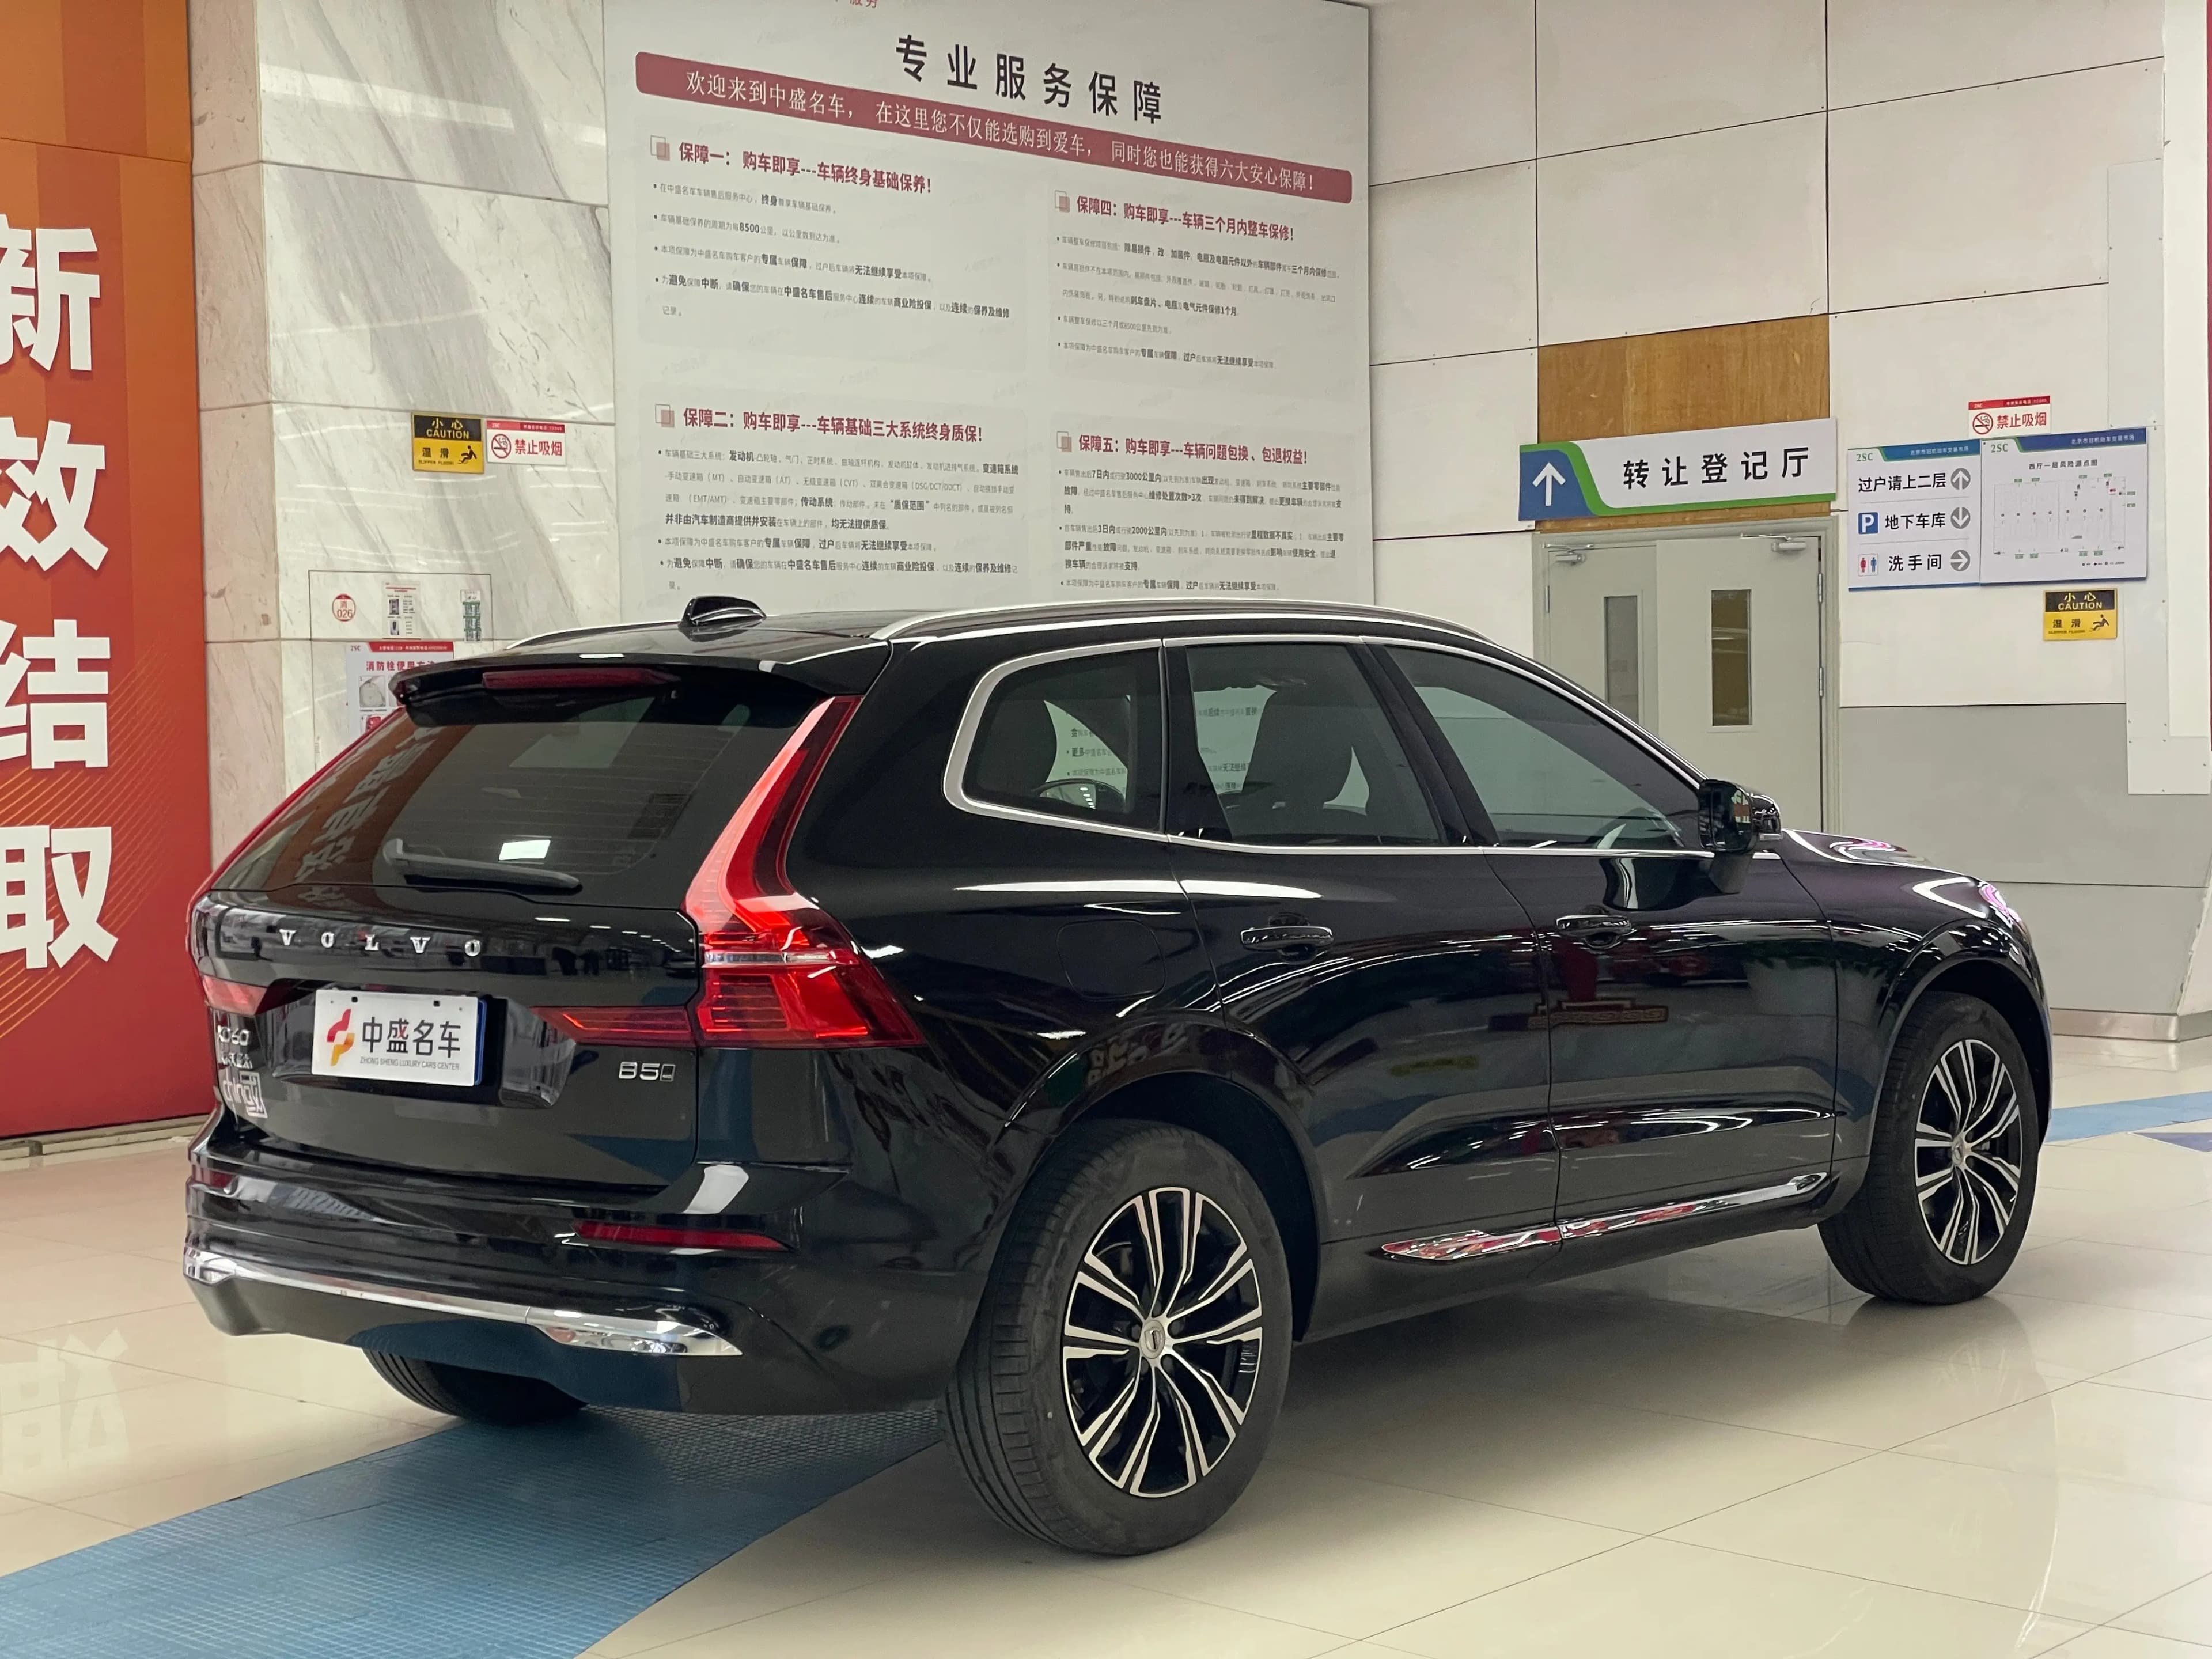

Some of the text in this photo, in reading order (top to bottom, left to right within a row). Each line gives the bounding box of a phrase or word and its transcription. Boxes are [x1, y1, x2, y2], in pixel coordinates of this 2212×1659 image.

[896, 35, 1161, 124] 专业服务保障
[431, 418, 463, 430] 小心
[1997, 412, 2047, 429] 禁止吸烟
[426, 429, 469, 439] CAUTION
[514, 438, 562, 456] 禁止吸烟
[1990, 444, 2008, 453] 2SC
[1856, 453, 1873, 461] 2SC
[1623, 446, 1809, 490] 转让登记厅
[1858, 472, 1946, 493] 过户请上二层
[1861, 512, 1946, 533] P 地下车库
[1889, 554, 1942, 572] 洗手间
[2058, 602, 2103, 610] CAUTION
[2064, 592, 2096, 603] 小心
[336, 609, 353, 618] 026
[0, 824, 119, 969] 取
[279, 928, 482, 957] VOLVO
[362, 1016, 461, 1058] 中盛名车
[360, 1056, 460, 1070] ZHONG SHENG LUXURY CARS CENTER
[619, 1061, 660, 1081] B5
